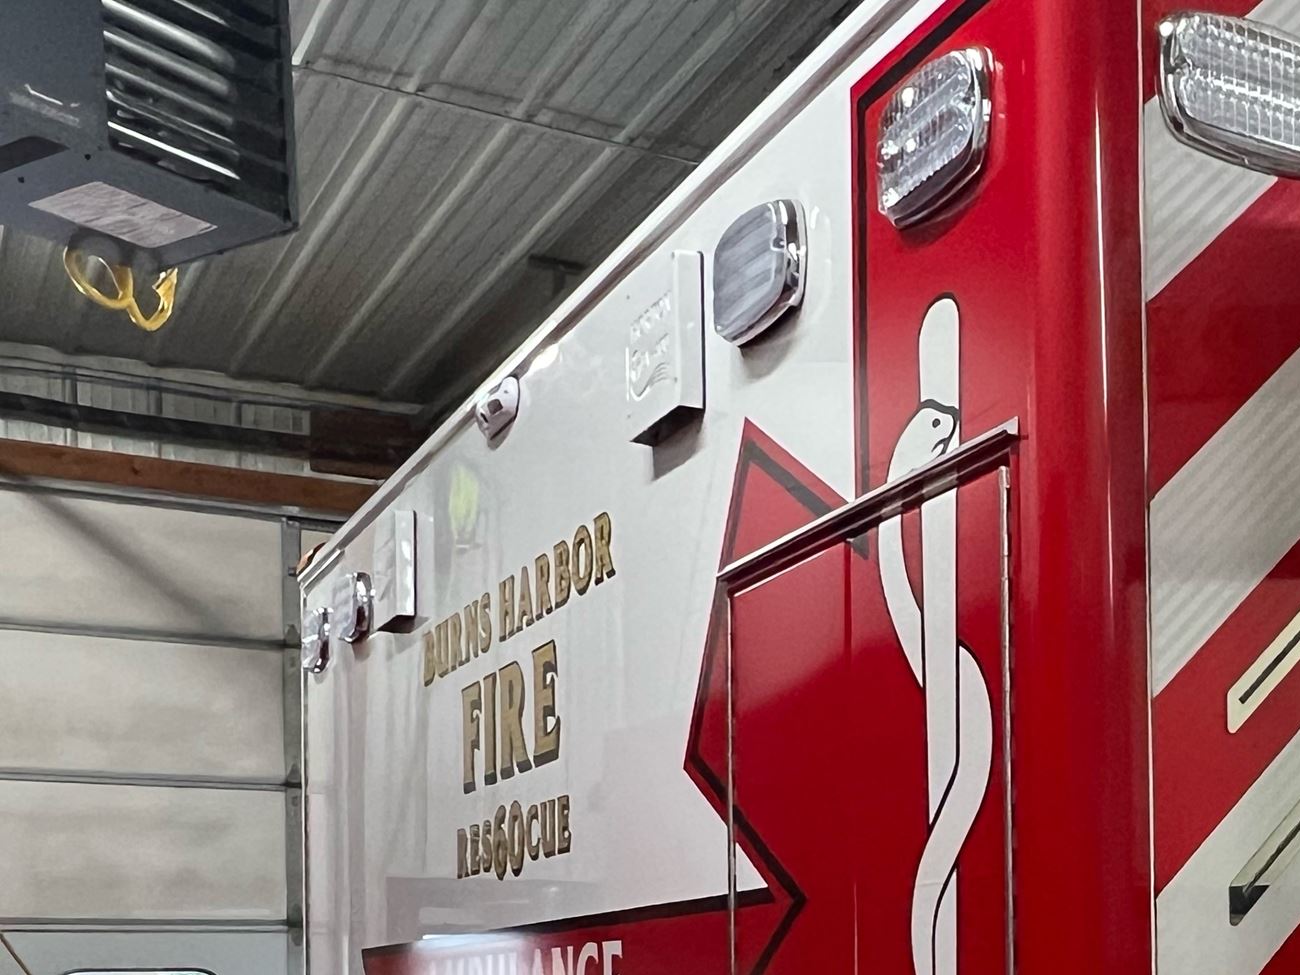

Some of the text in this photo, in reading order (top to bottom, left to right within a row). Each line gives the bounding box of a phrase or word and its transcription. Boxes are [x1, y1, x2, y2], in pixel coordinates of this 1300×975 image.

[424, 512, 616, 687] BURNS HARBOR
[461, 639, 561, 794] FIRE
